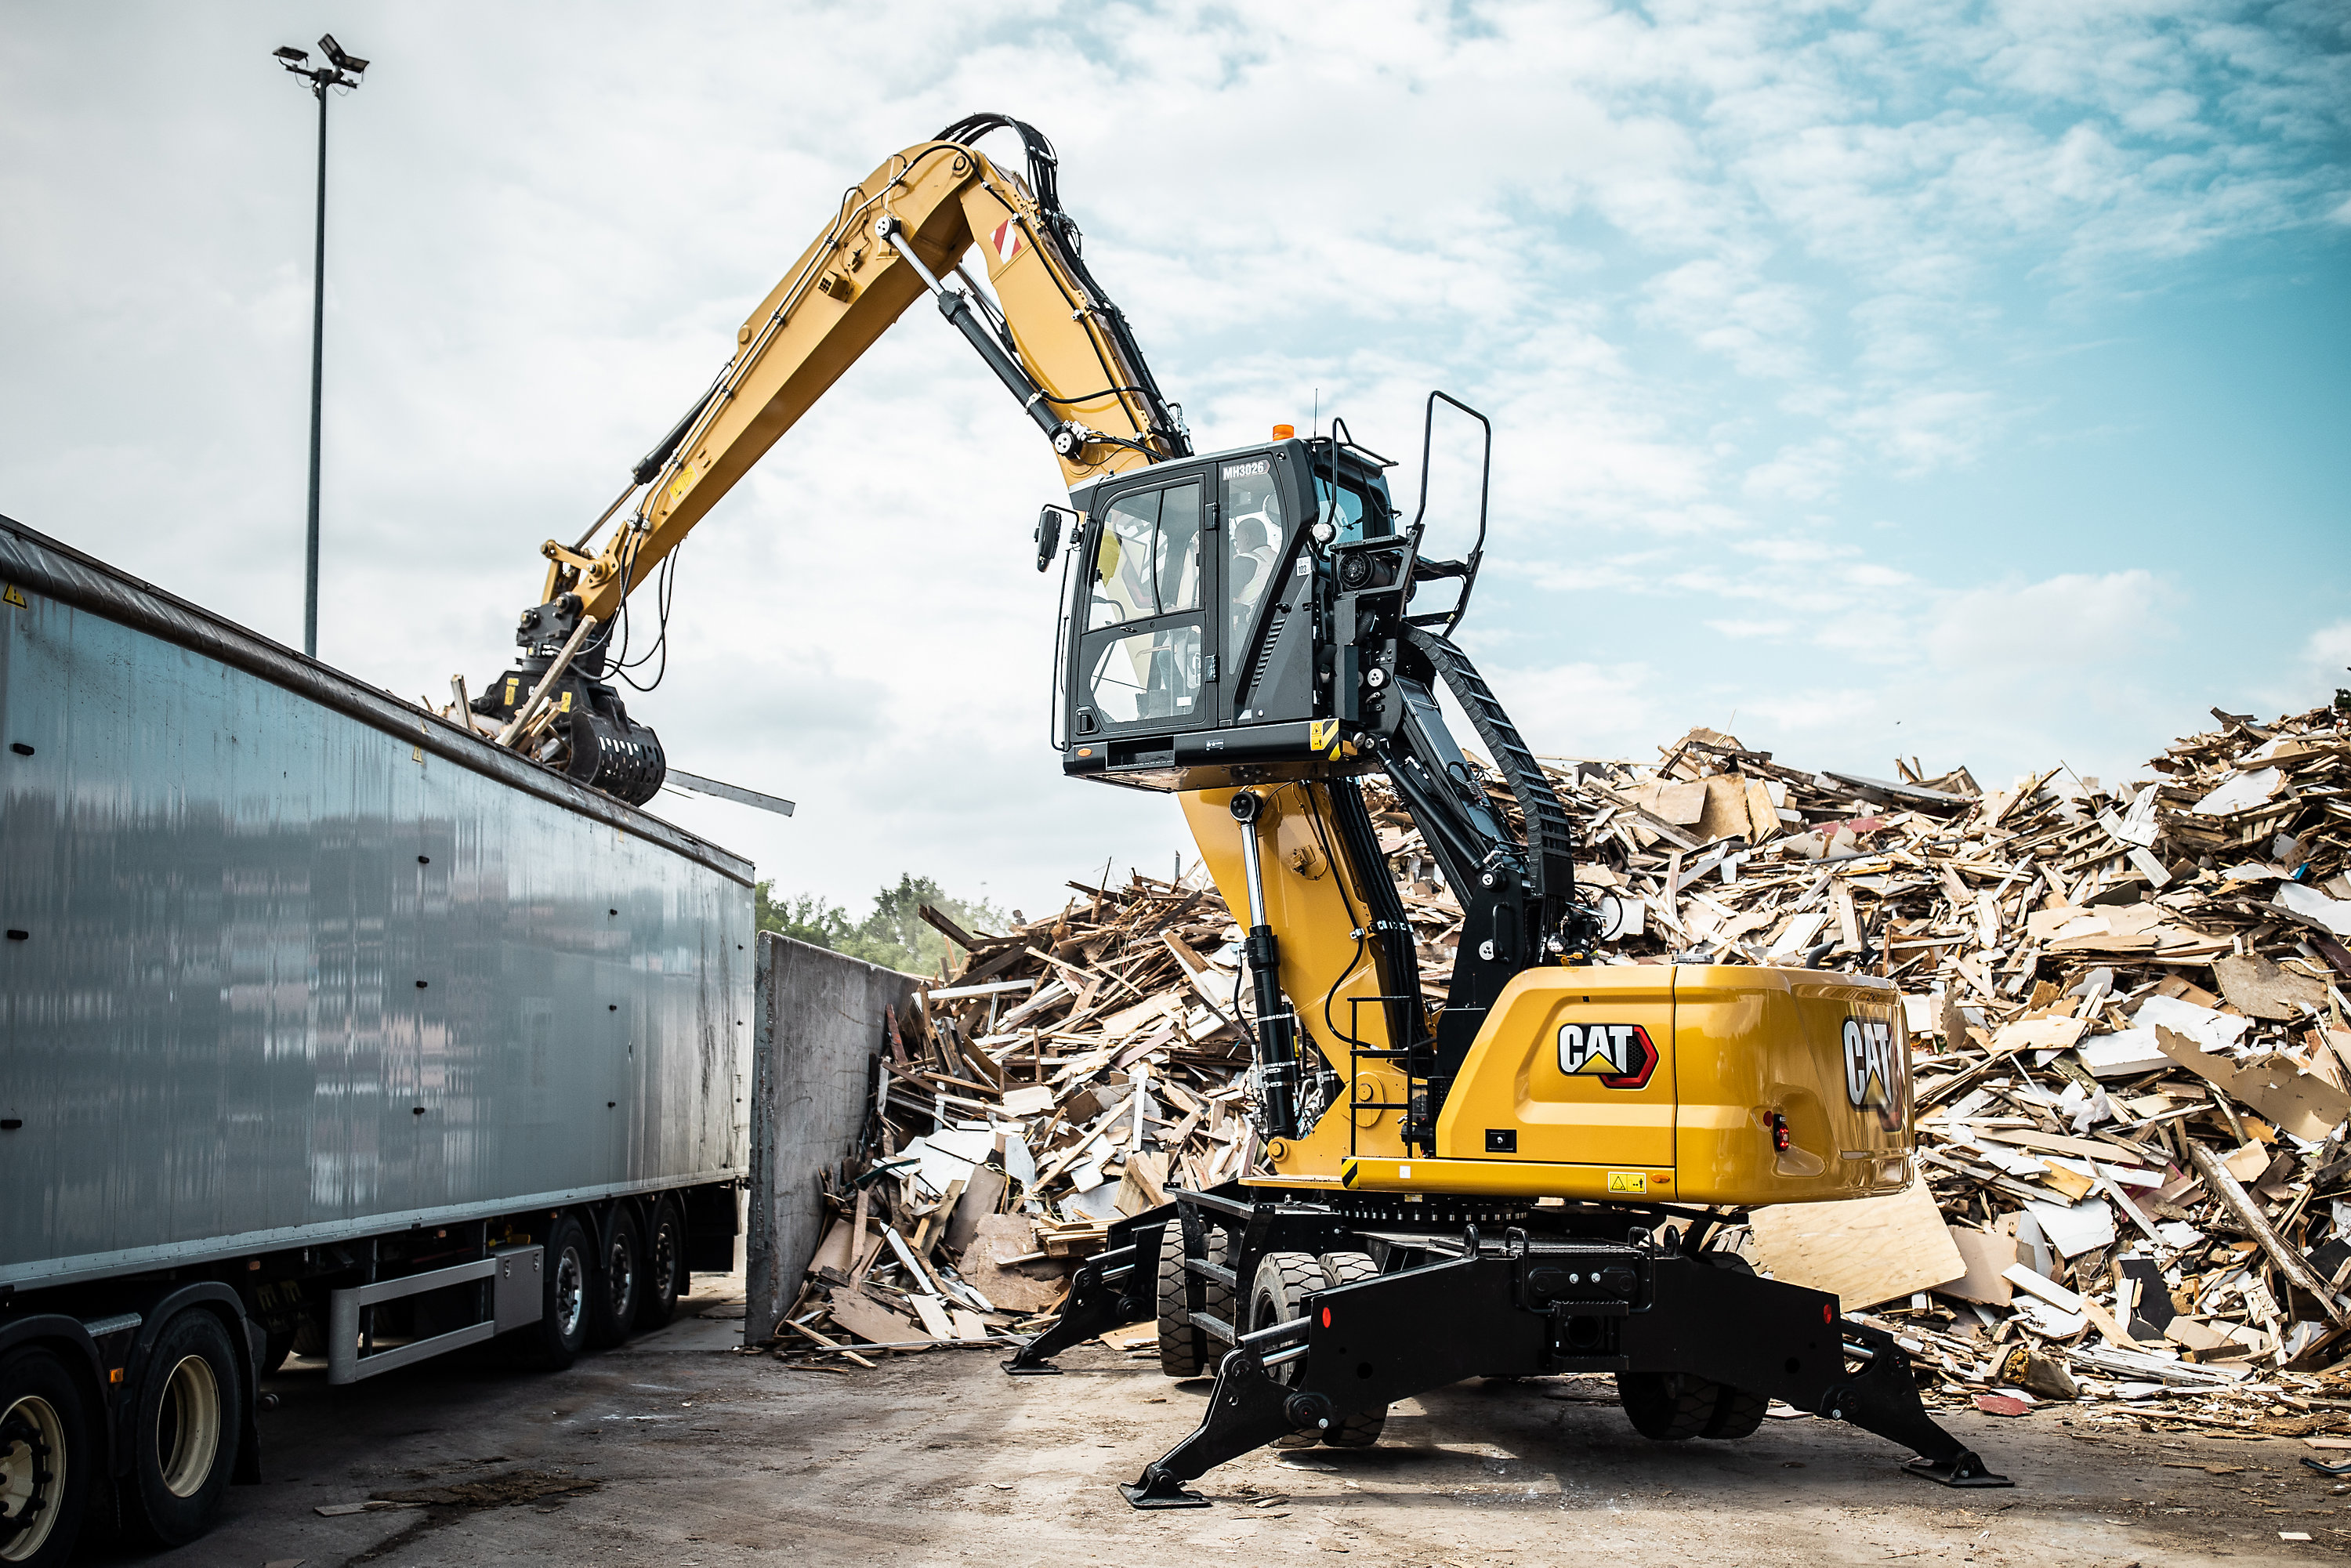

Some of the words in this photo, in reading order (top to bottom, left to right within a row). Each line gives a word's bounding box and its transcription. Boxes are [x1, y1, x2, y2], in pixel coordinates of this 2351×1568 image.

[1223, 462, 1264, 479] MH3026
[1298, 564, 1307, 574] 103
[1559, 1025, 1633, 1074] CAT
[1844, 1020, 1893, 1105] CAT
